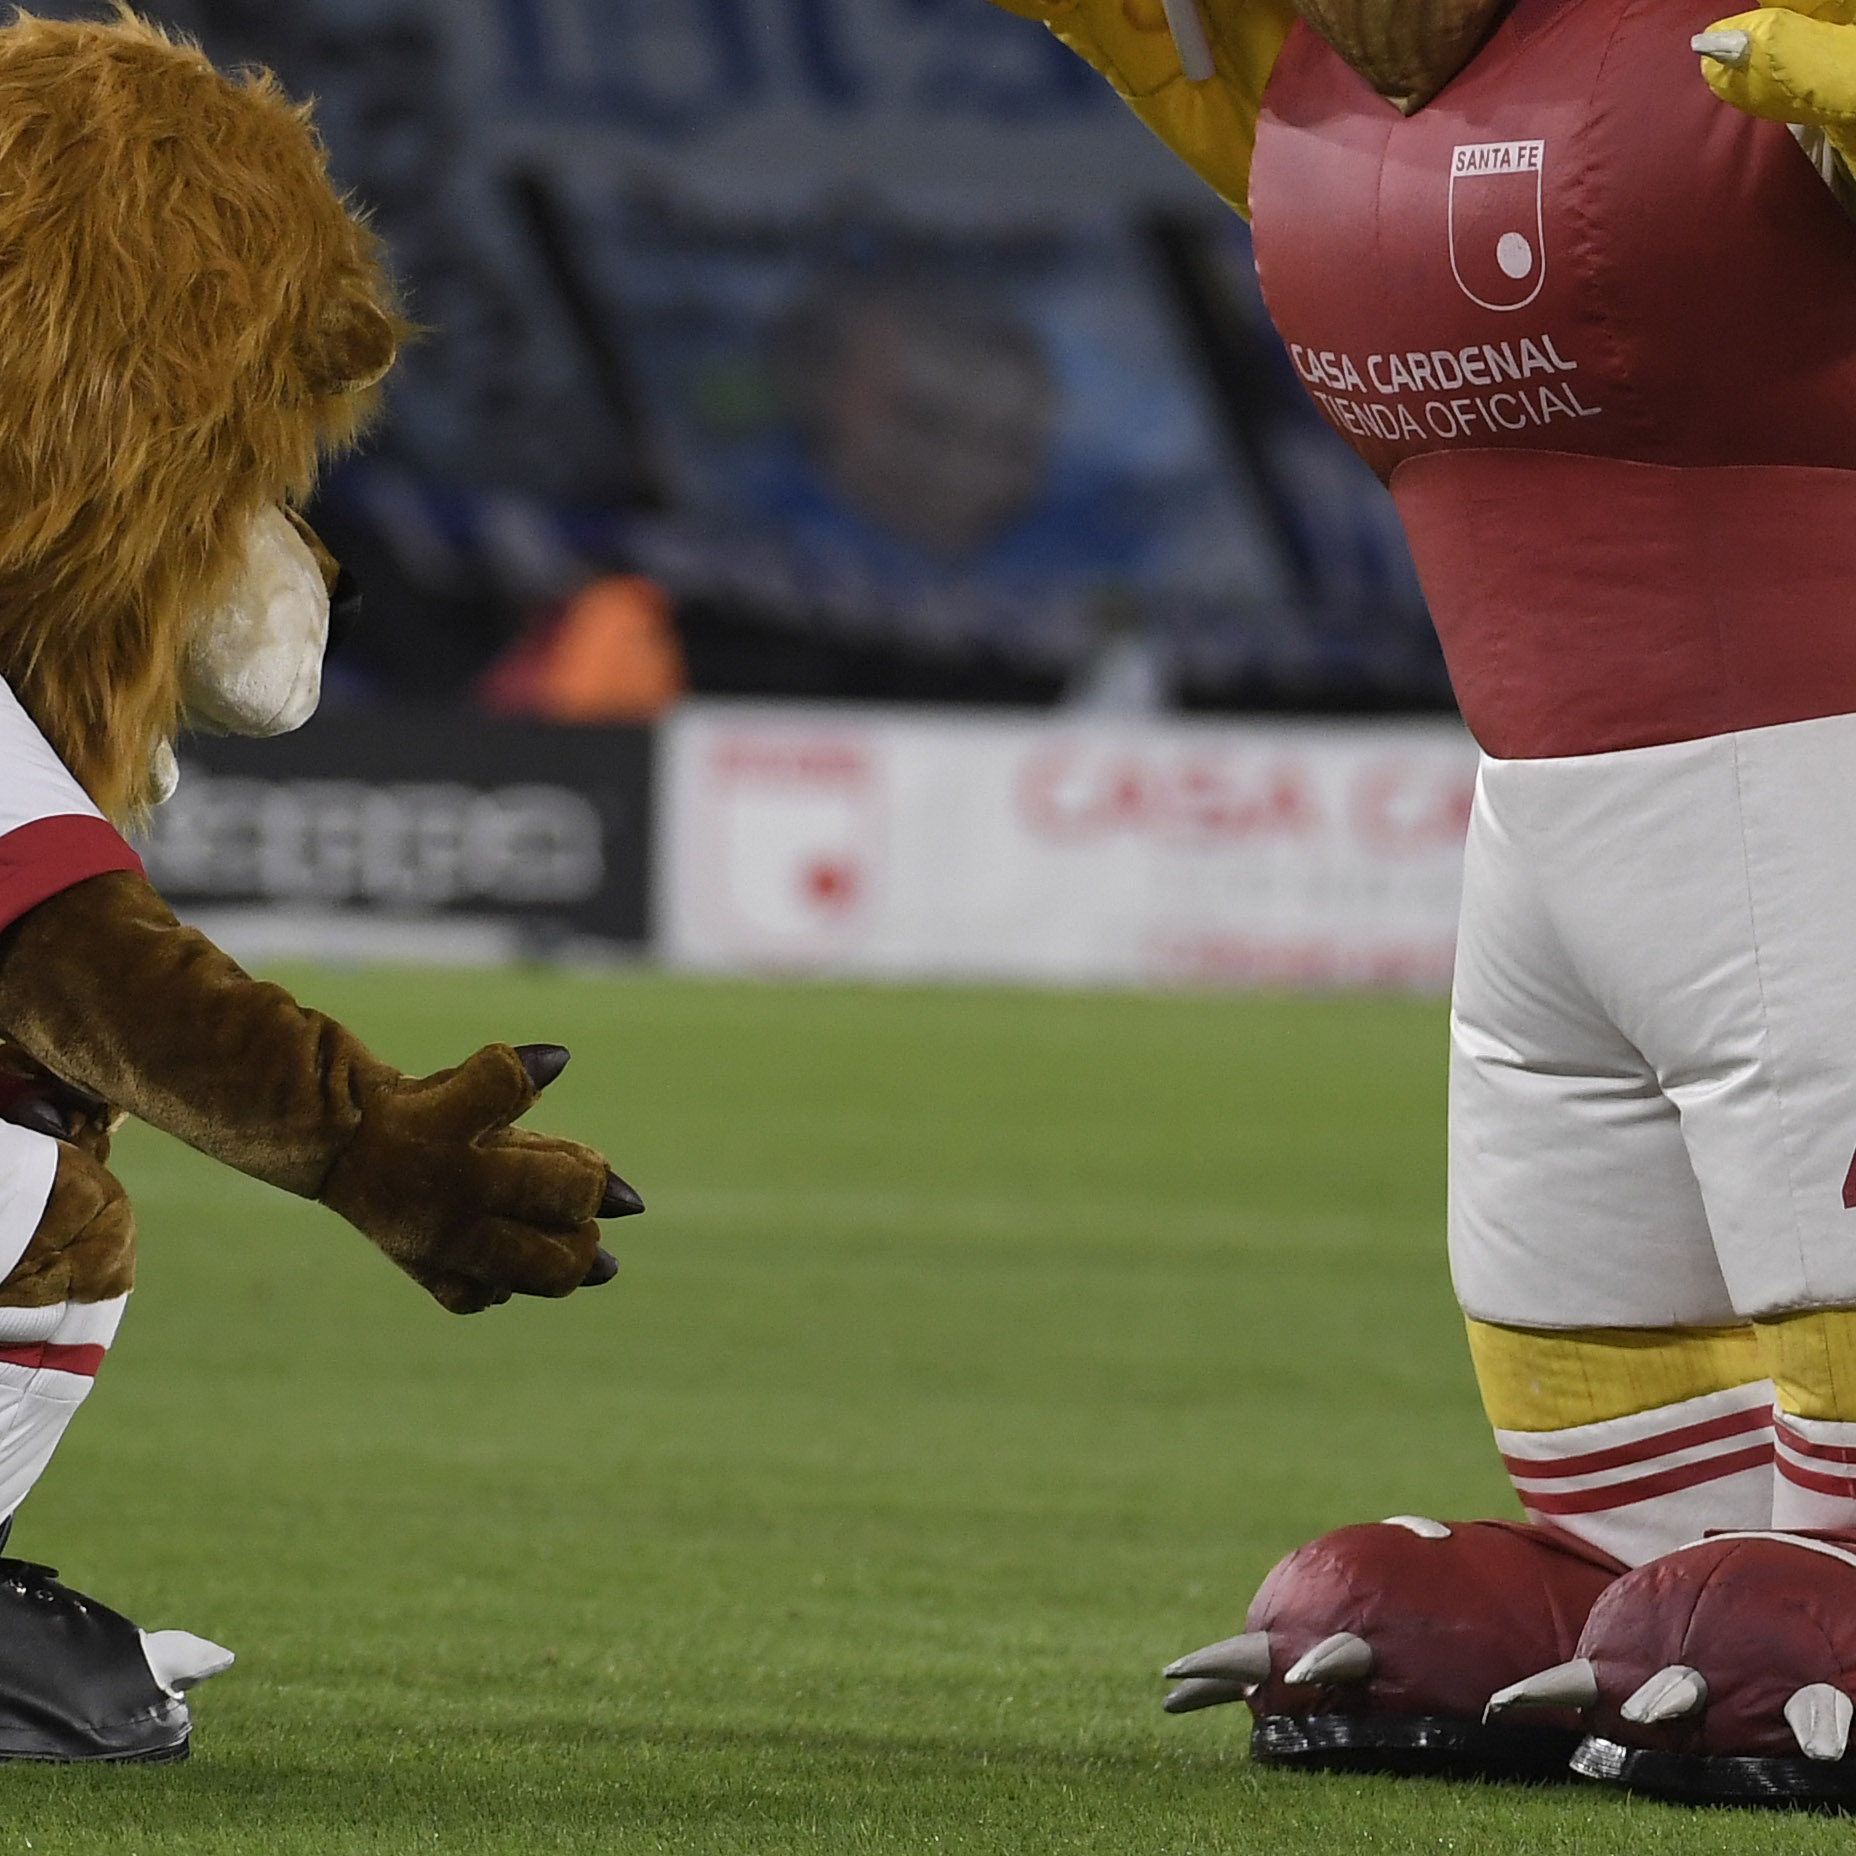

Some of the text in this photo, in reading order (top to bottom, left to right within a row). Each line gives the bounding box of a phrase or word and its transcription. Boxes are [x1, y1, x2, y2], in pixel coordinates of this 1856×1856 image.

[1456, 145, 1538, 171] SANTA FE
[1290, 334, 1578, 394] CASA CARDENAL
[1314, 382, 1602, 441] TIENDA OFICIAL
